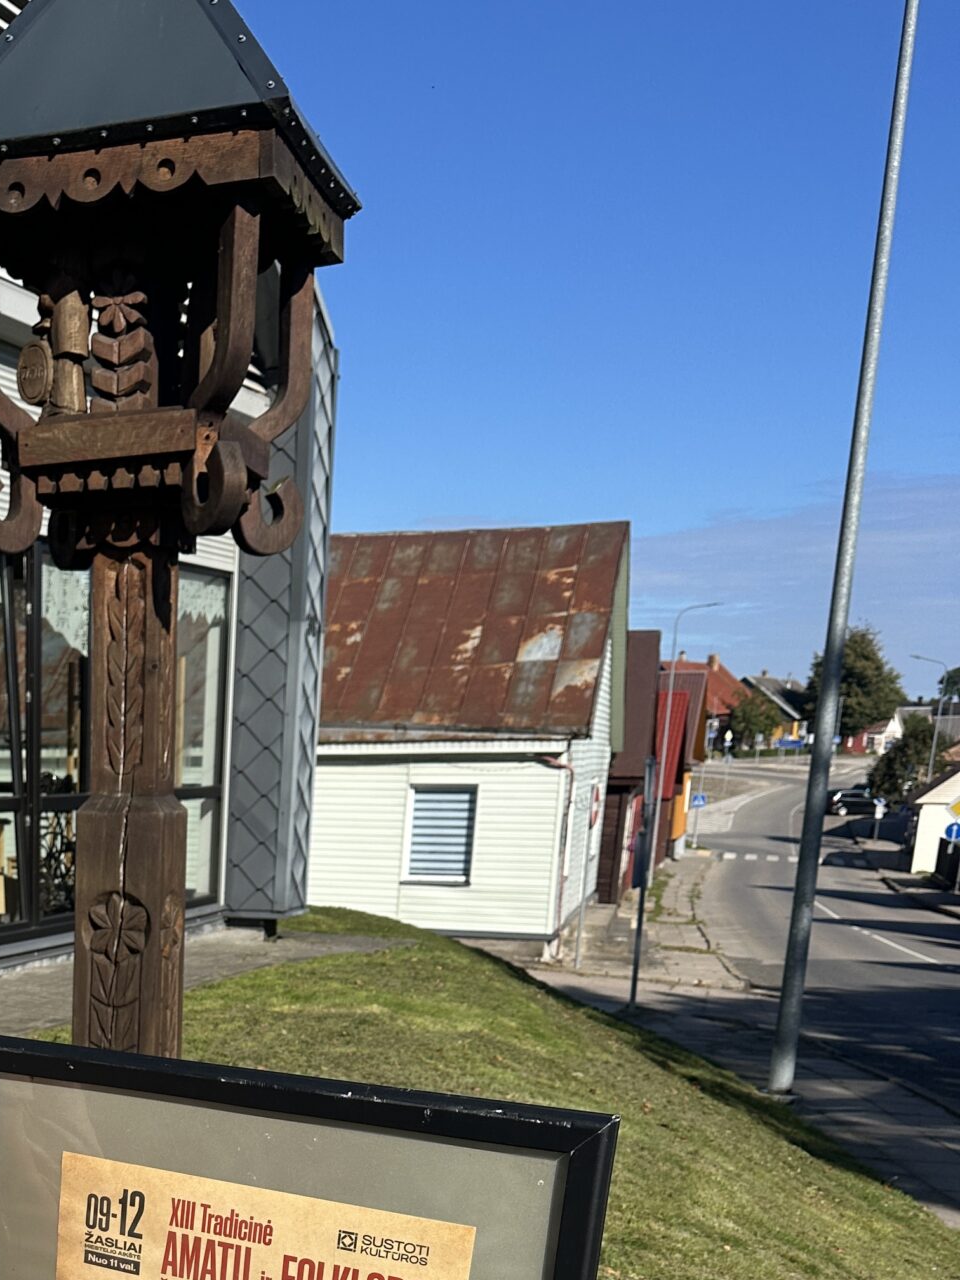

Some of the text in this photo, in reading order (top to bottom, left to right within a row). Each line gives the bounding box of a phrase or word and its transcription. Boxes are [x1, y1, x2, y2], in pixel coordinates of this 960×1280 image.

[85, 1189, 146, 1240] 09-12
[169, 1197, 274, 1246] XIII Tradicinė
[84, 1230, 142, 1254] ŽASLIAI
[361, 1234, 430, 1257] SUSTOTI
[87, 1253, 137, 1272] Nuo 11 val.
[360, 1245, 428, 1266] KULTŪROS
